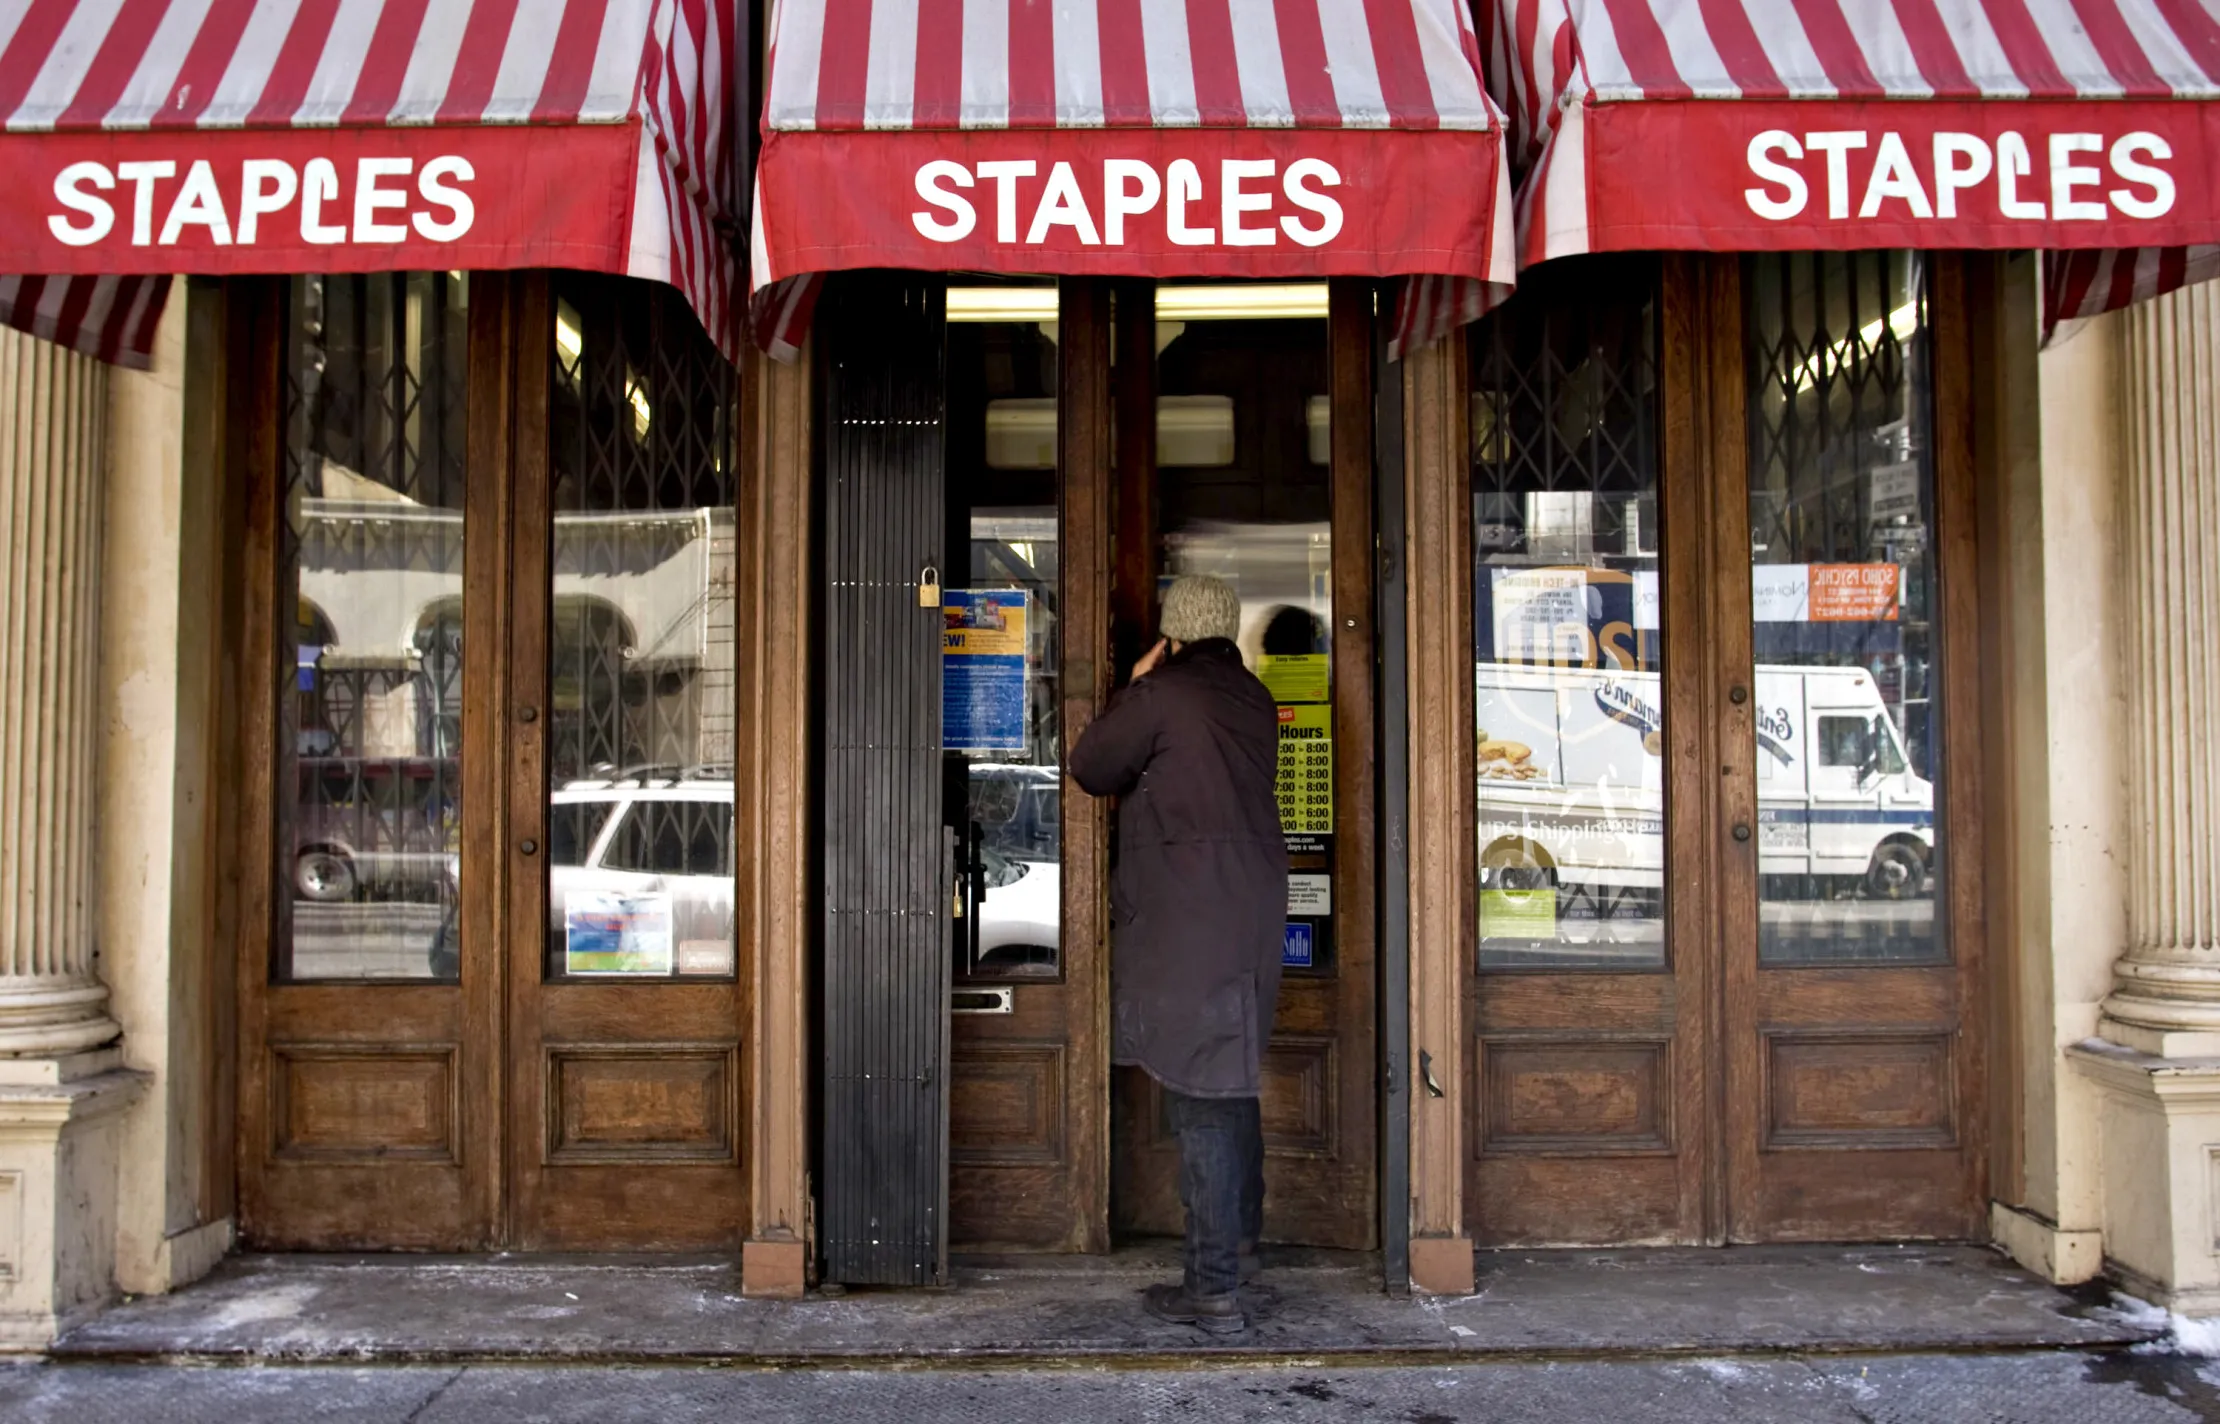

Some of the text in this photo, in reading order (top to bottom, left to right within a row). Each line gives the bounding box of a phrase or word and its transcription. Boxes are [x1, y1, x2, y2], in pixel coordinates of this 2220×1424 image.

[1744, 129, 2177, 221] STAPLES
[47, 155, 476, 247] STAPLES
[911, 157, 1345, 248] STAPLES
[1280, 725, 1324, 739] Hours
[1280, 743, 1295, 753] :00
[1306, 743, 1329, 753] 8:00
[1278, 756, 1295, 767] :00
[1306, 756, 1329, 767] 8:00
[1306, 769, 1329, 779] 8:00
[1306, 782, 1329, 792] 8:00
[1306, 795, 1329, 805] 8:00
[1280, 808, 1295, 817] :00
[1306, 808, 1329, 817] 6:00
[1306, 820, 1329, 831] 6:00
